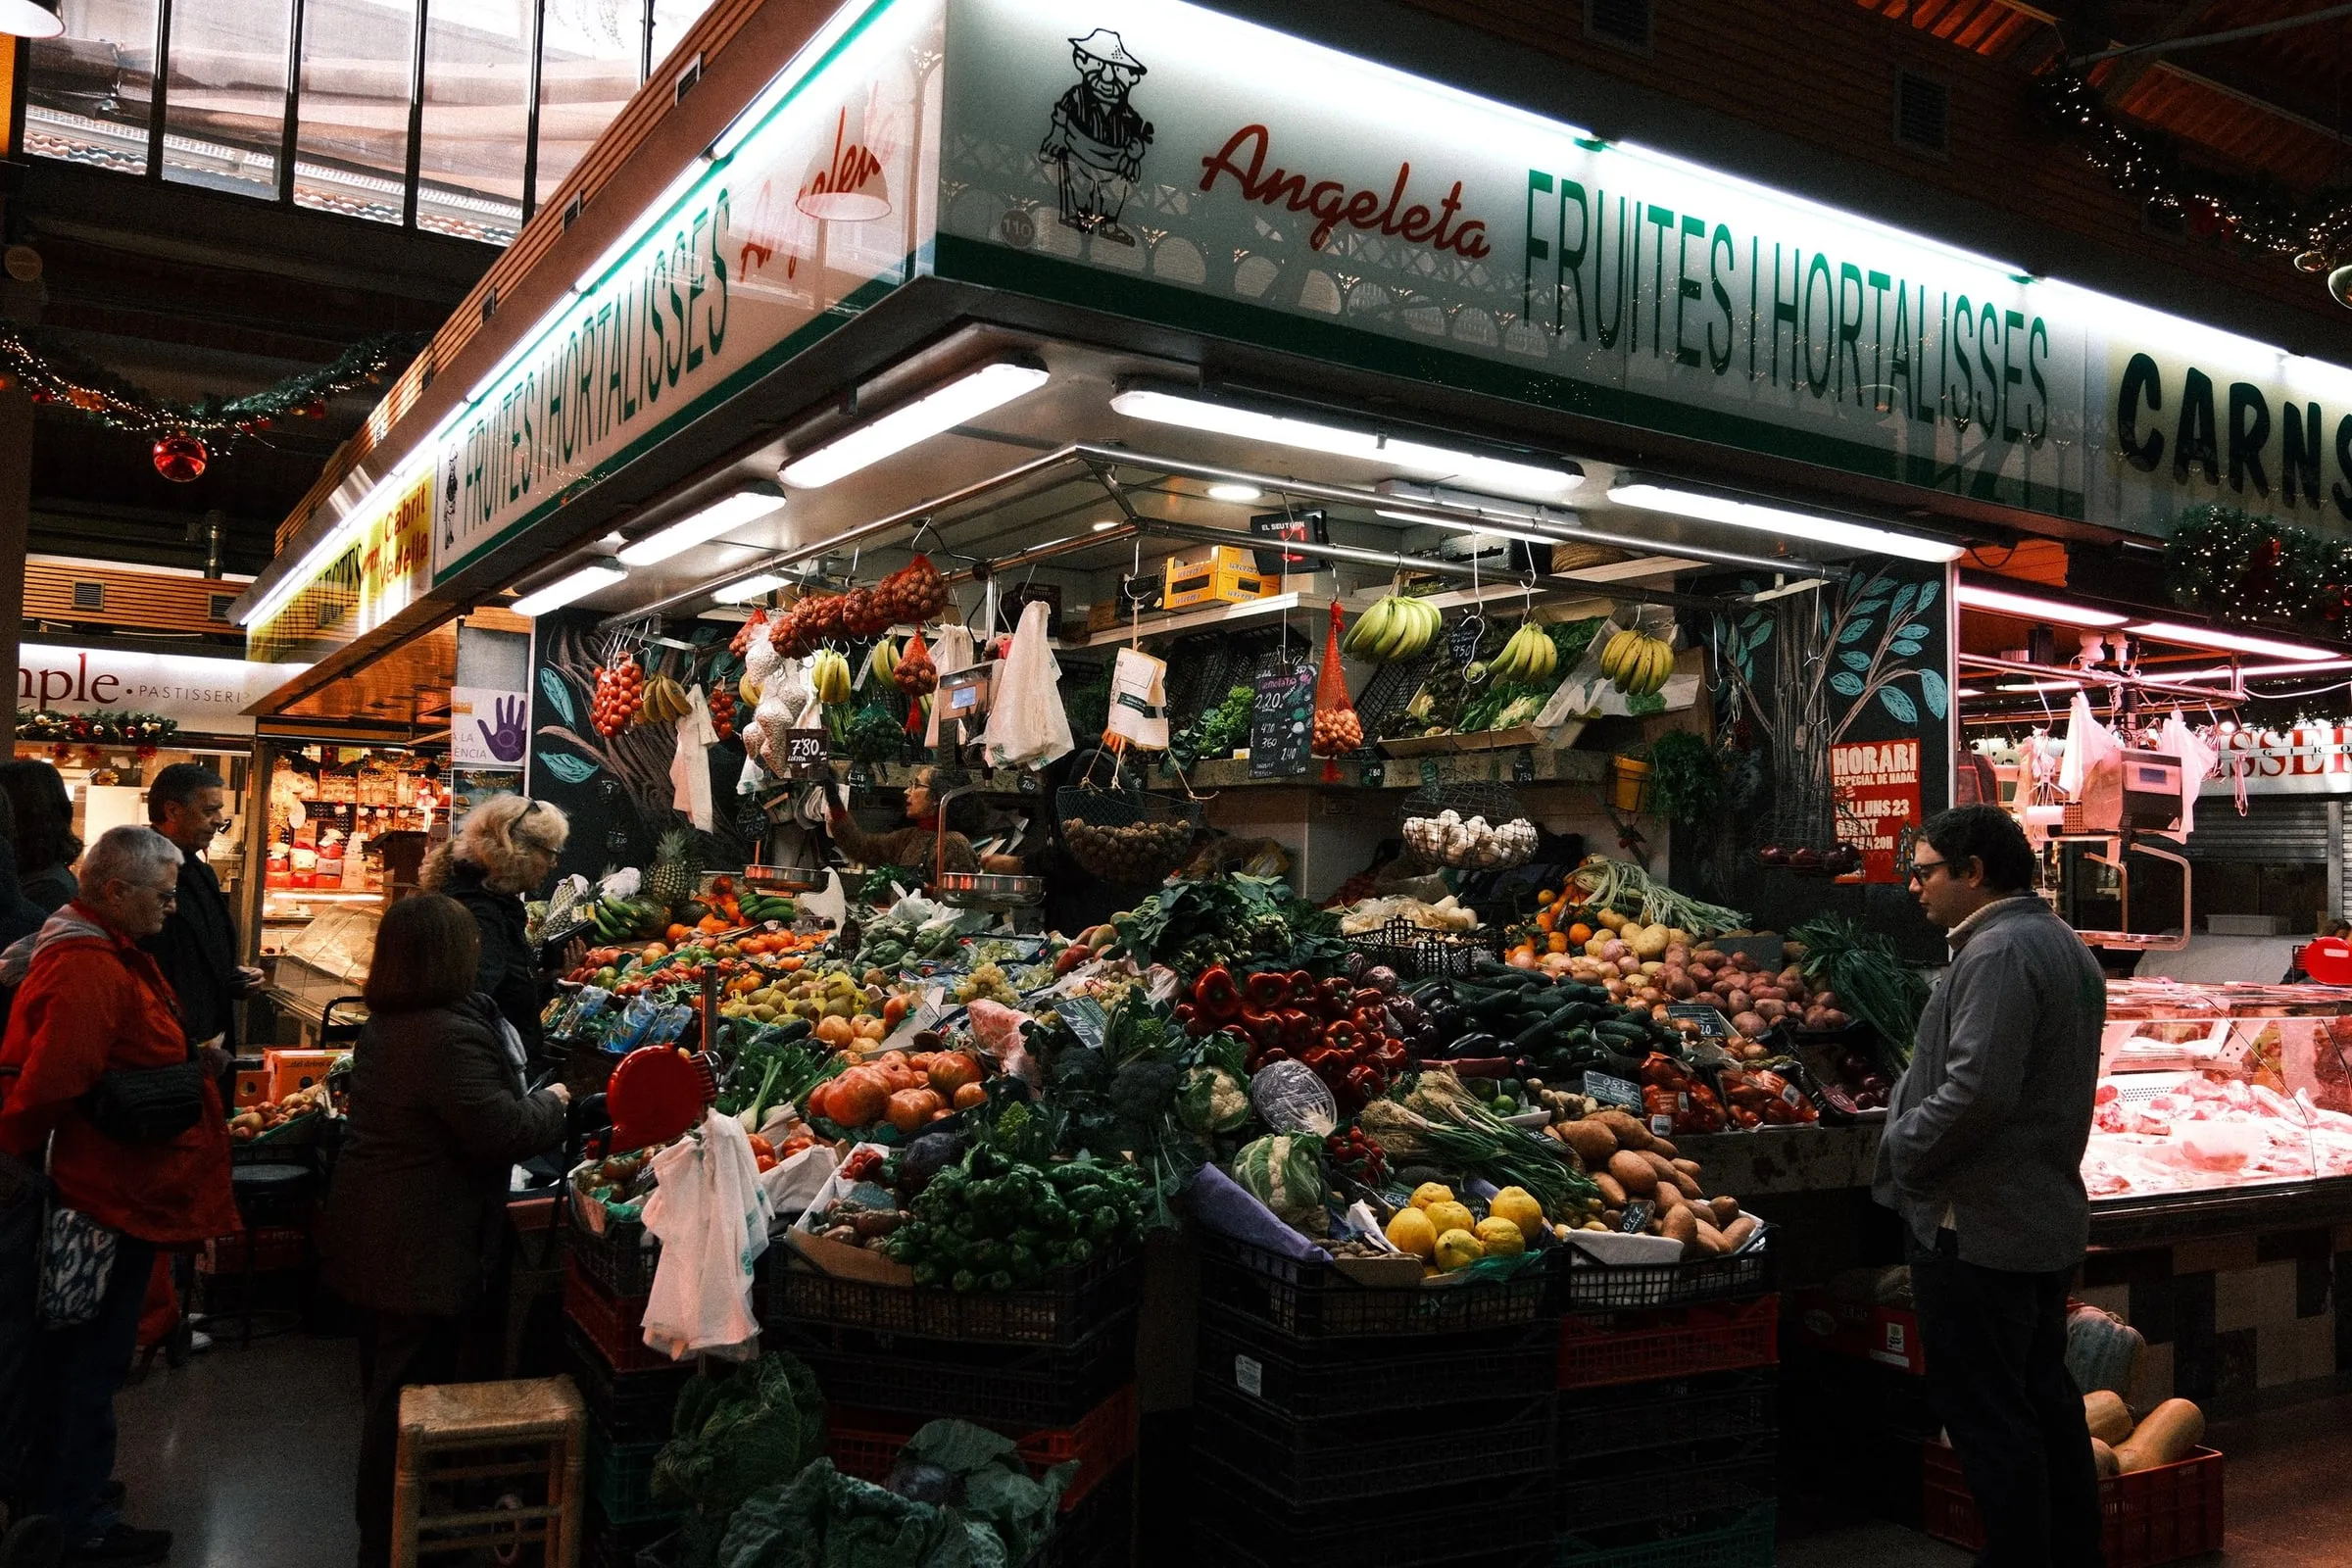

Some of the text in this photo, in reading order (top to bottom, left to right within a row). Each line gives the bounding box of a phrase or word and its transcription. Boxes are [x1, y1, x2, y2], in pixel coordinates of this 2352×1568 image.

[1199, 123, 1491, 259] Angeleta
[1523, 169, 2048, 451] FRUITES I HORTALISSES
[464, 187, 730, 537] FRUITES I HORTALISSES
[385, 482, 426, 543] Cabrit
[379, 531, 428, 588] Vedella
[139, 685, 249, 704] PASTISSERI
[1832, 742, 1917, 775] HORARI
[1834, 774, 1876, 787] ESPECIAL
[1877, 773, 1888, 785] DE
[1891, 799, 1910, 816] 23
